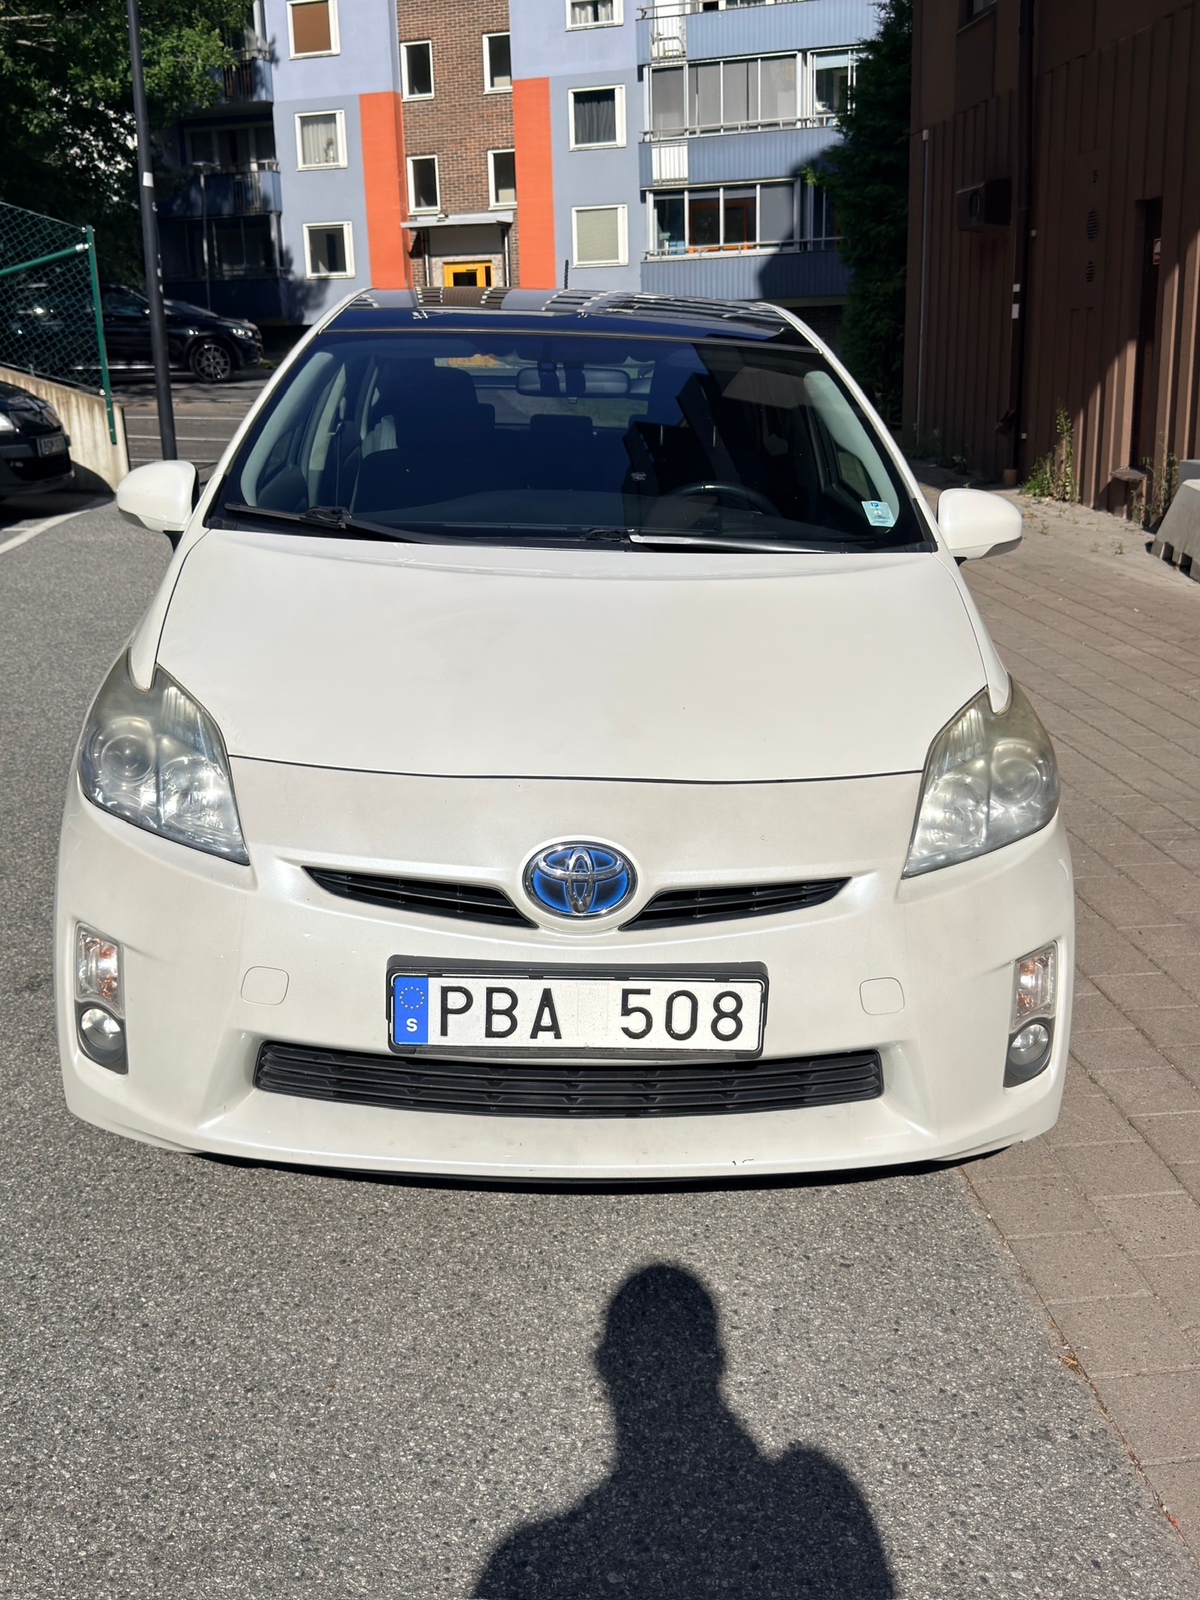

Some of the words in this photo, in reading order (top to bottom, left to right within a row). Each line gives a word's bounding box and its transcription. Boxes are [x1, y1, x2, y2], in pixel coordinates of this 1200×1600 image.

[406, 1018, 418, 1032] S
[440, 985, 562, 1039] PBA
[620, 988, 743, 1041] 508
